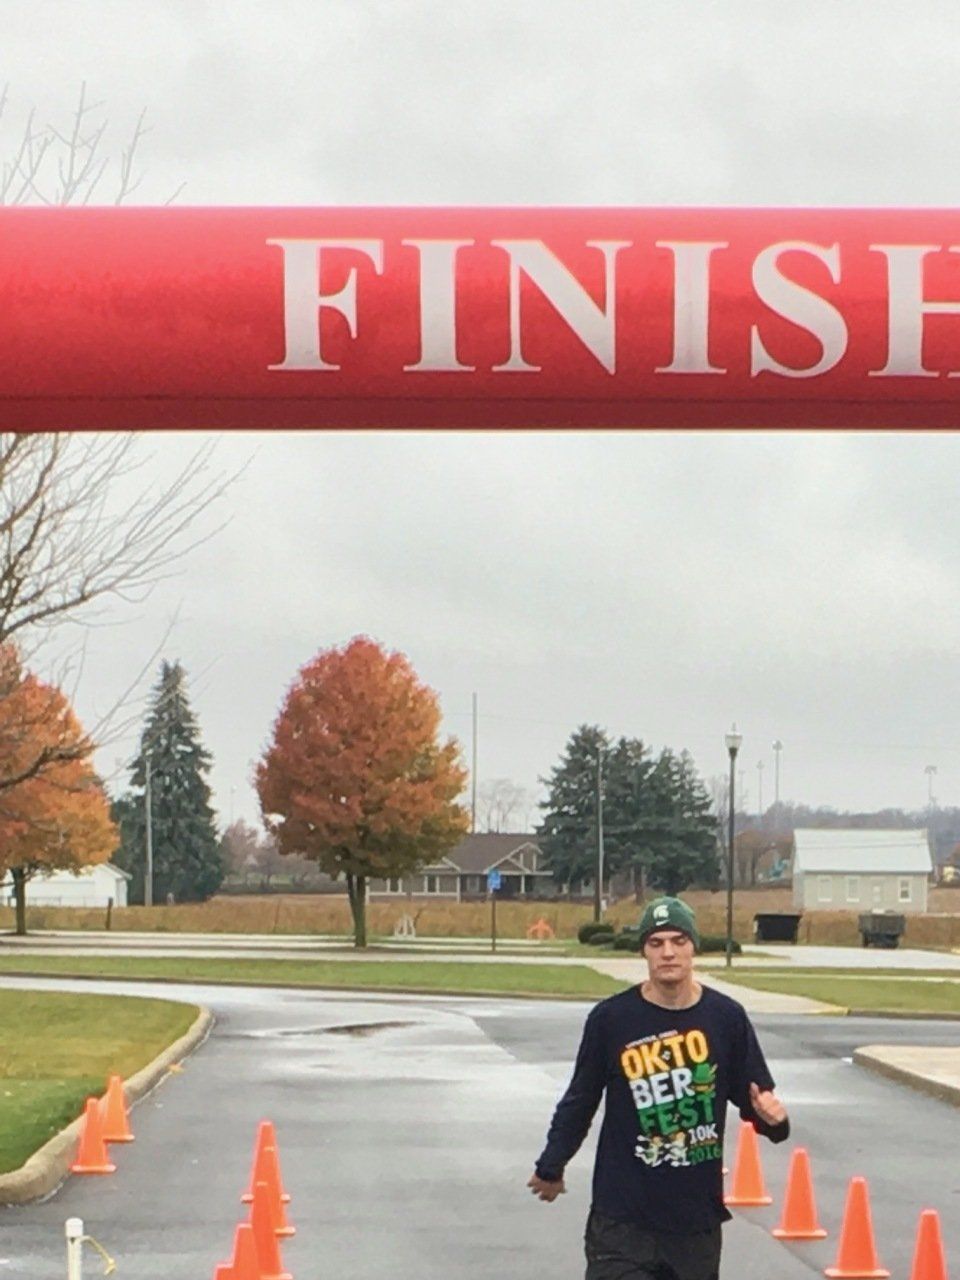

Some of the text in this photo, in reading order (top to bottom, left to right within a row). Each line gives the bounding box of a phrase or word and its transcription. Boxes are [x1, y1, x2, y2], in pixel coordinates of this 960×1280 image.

[620, 1029, 709, 1080] OKTO
[628, 1067, 696, 1110] BER
[637, 1090, 717, 1135] FEST
[688, 1123, 718, 1145] 10K
